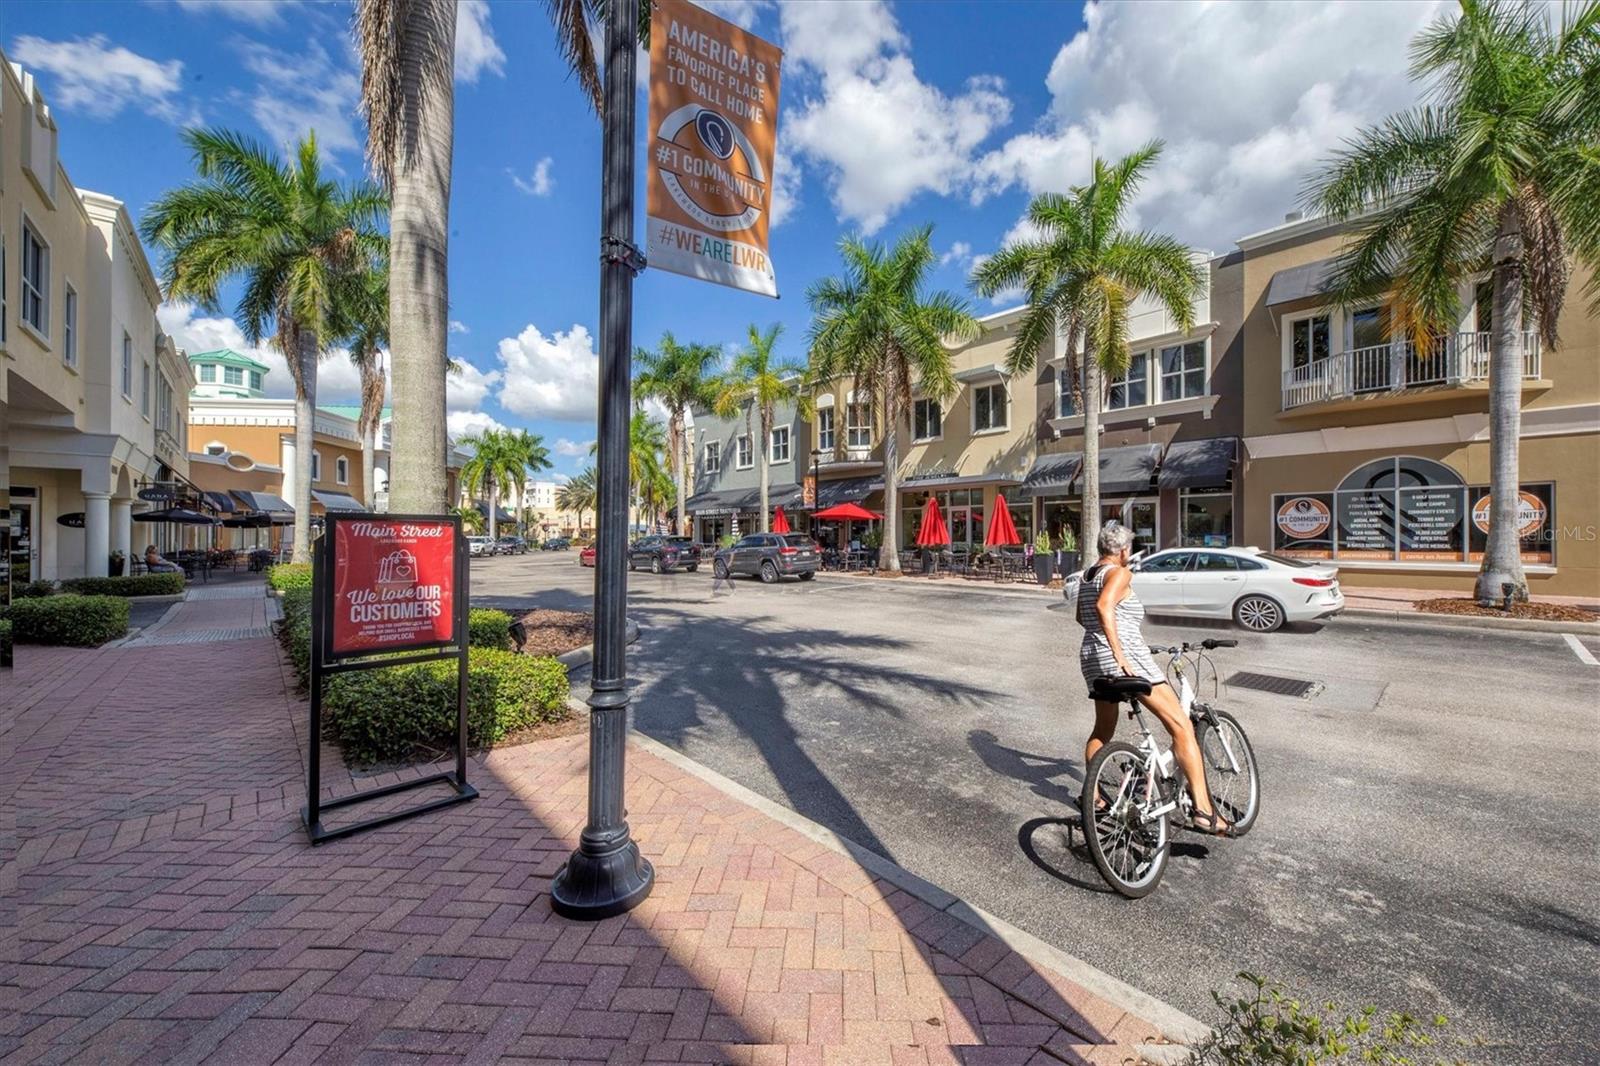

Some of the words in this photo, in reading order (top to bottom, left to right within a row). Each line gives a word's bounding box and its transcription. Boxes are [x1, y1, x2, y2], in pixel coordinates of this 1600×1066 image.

[669, 20, 766, 83] AMERICA'S
[668, 47, 725, 86] FAVORITE
[728, 71, 766, 105] PLACE
[667, 65, 686, 86] TO
[690, 75, 722, 106] CALL
[726, 95, 763, 125] HOME
[656, 145, 679, 168] #1
[683, 154, 766, 204] COMMUNITY
[690, 178, 700, 192] IN
[704, 182, 721, 197] THE
[659, 225, 766, 273] #WEARELWR
[352, 522, 397, 538] Main
[400, 524, 443, 537] Street
[347, 587, 378, 604] We
[381, 587, 416, 601] love
[416, 585, 441, 600] OUR
[350, 601, 441, 623] CUSTOMERS
[379, 633, 415, 641] #SHOPLOCAL
